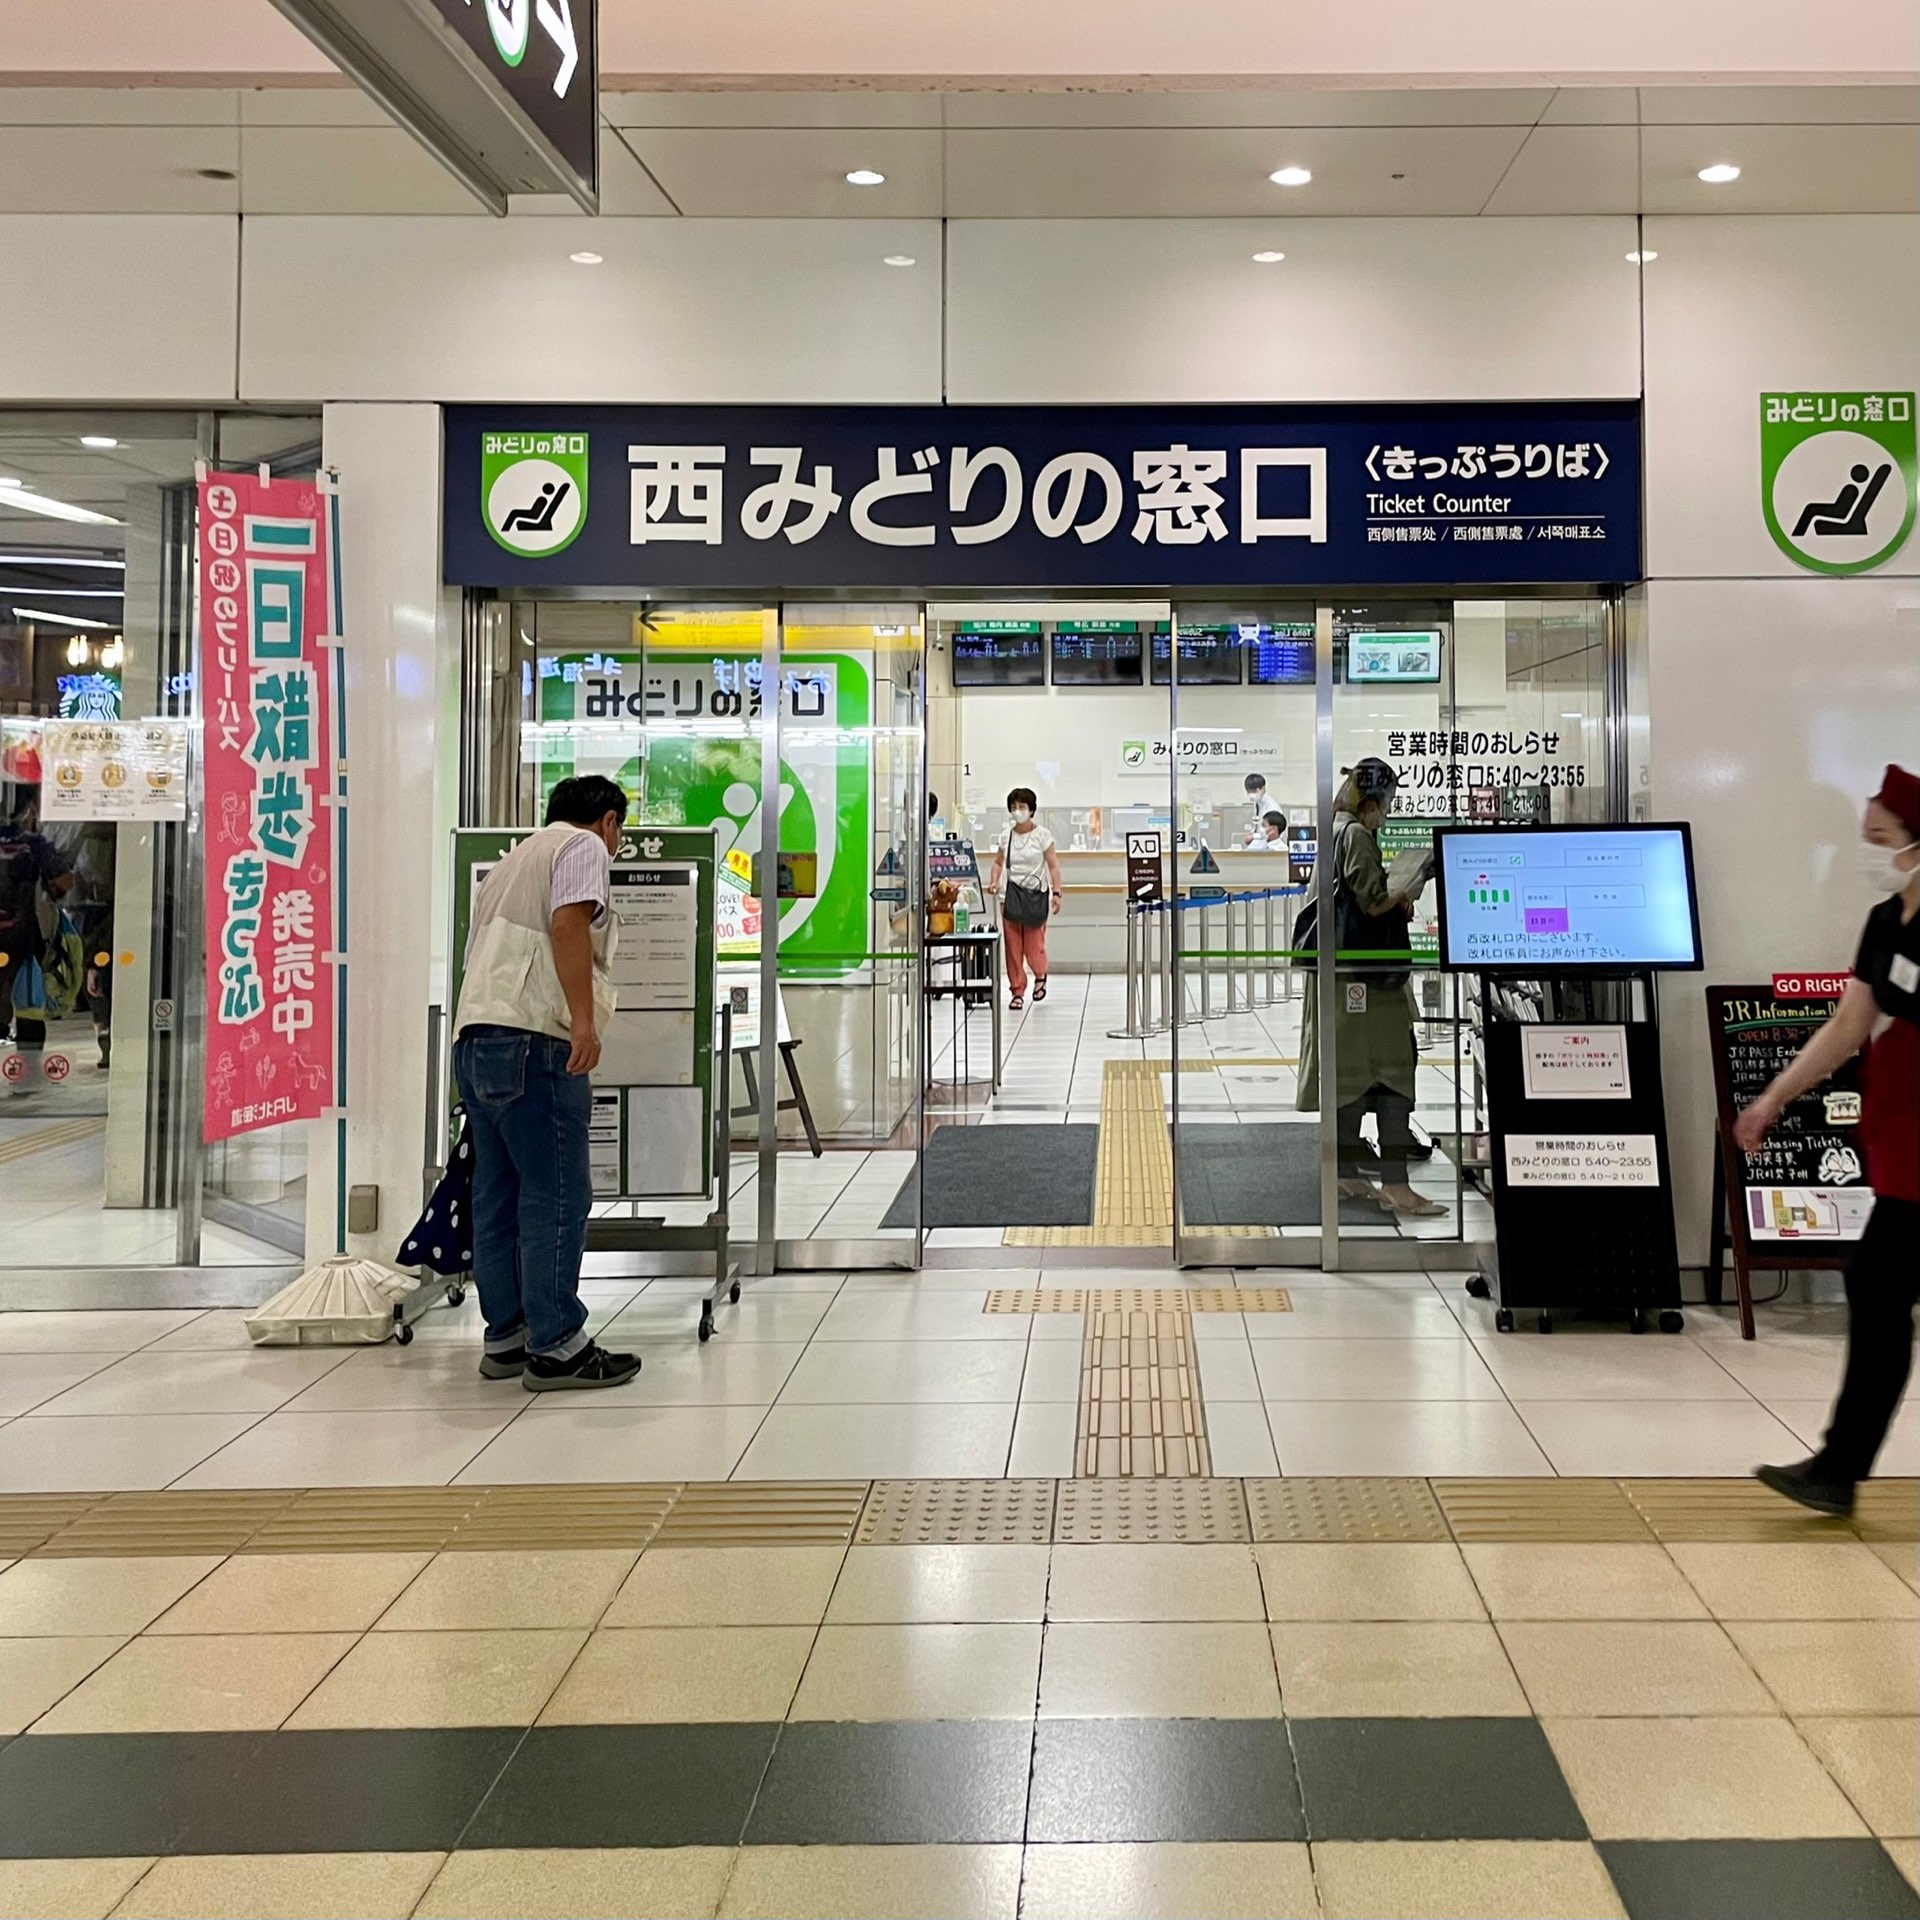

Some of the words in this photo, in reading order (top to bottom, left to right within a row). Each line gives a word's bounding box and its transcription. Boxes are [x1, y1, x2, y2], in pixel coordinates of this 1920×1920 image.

[1766, 395, 1910, 423] みどりの窓口
[485, 434, 585, 455] みどりの窓口
[627, 444, 1328, 547] 西みどりの窓口
[1366, 493, 1426, 514] Ticket
[1432, 493, 1512, 514] Counter
[1387, 731, 1560, 756] 営業時間のおしらせ
[1190, 763, 1199, 775] 2
[1131, 839, 1157, 854] 入口
[1776, 979, 1801, 993] GO
[1723, 1000, 1752, 1023] JR
[1755, 1001, 1828, 1020] Information
[1737, 1029, 1769, 1043] OPEN
[1728, 1046, 1747, 1059] JR
[1748, 1046, 1774, 1058] PASS
[1535, 1140, 1626, 1151] 営業時間のおしらせ
[1804, 1135, 1844, 1151] Tickets
[1511, 1156, 1581, 1167] 西みどりの窓口
